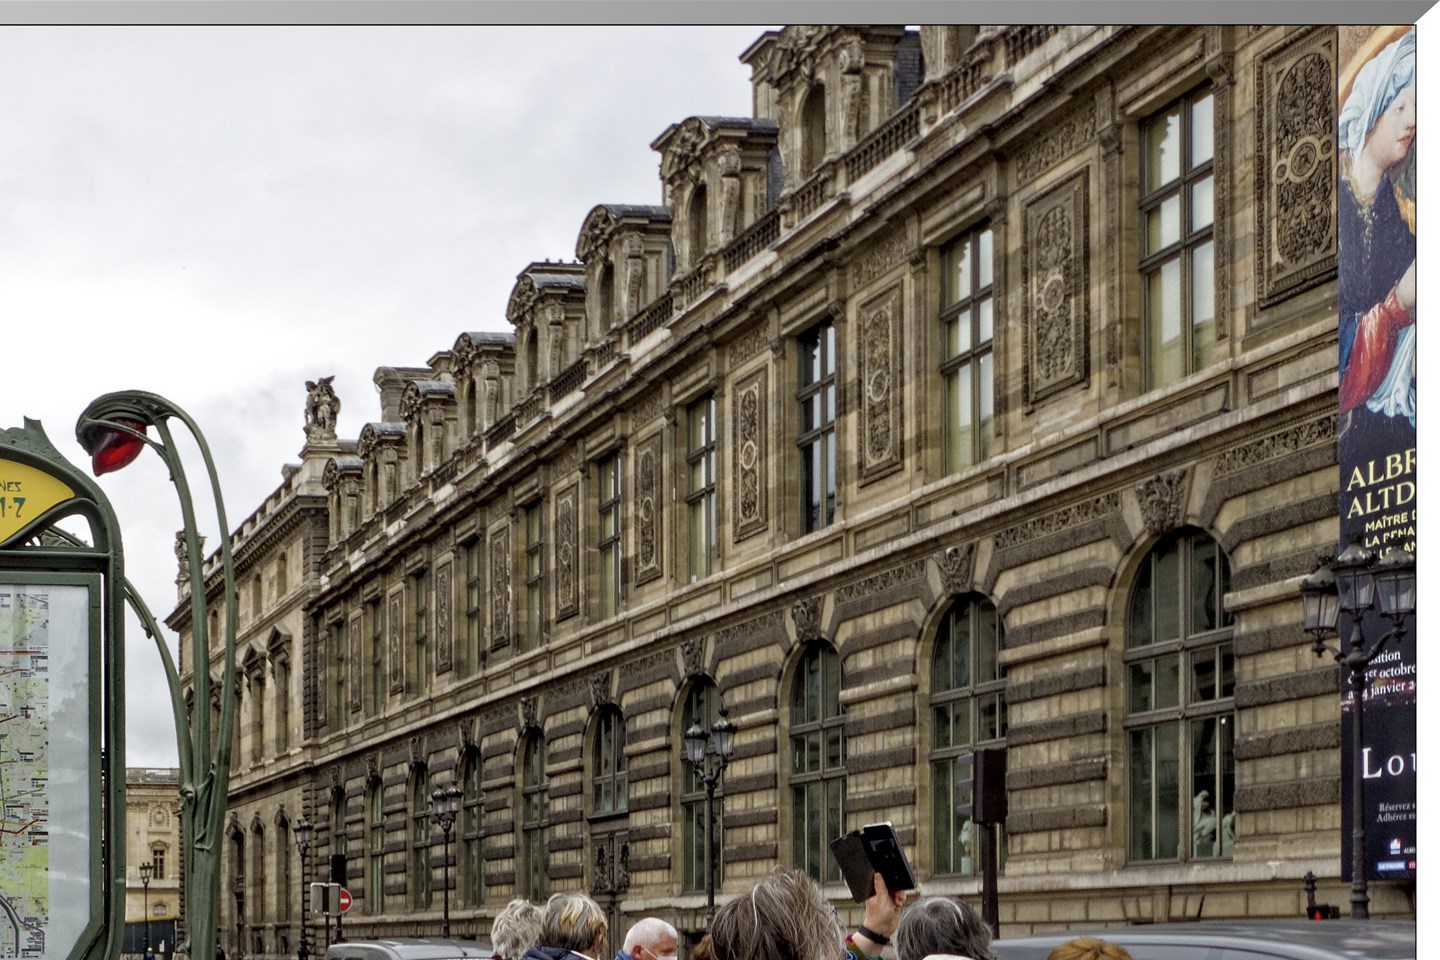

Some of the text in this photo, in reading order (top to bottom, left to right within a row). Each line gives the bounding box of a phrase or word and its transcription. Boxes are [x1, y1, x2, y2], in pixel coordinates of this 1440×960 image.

[1365, 512, 1408, 533] MAÎTRE
[1365, 535, 1380, 548] LA
[1371, 680, 1406, 699] janvier
